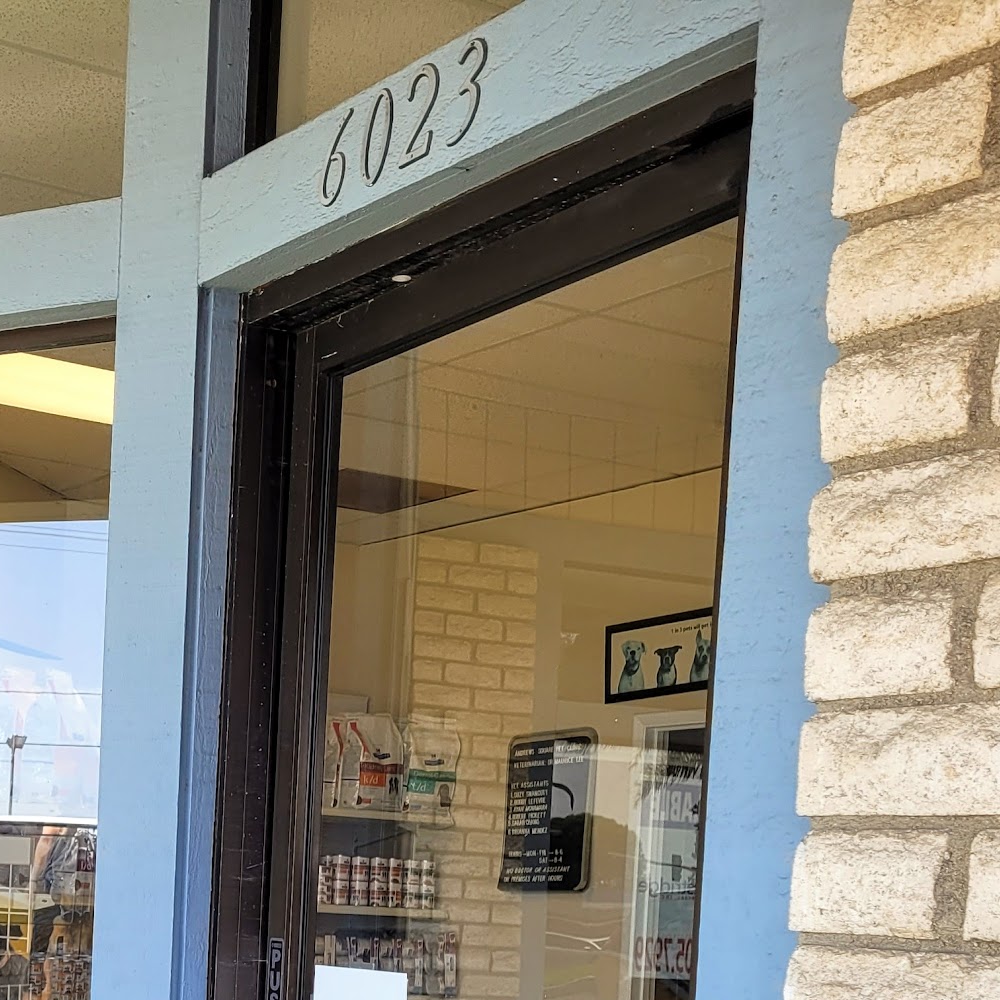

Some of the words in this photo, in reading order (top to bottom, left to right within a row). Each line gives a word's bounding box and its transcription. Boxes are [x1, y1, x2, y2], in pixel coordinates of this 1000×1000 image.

[320, 37, 489, 208] 6023
[363, 776, 379, 785] k/d
[543, 865, 571, 873] ASSISTANT
